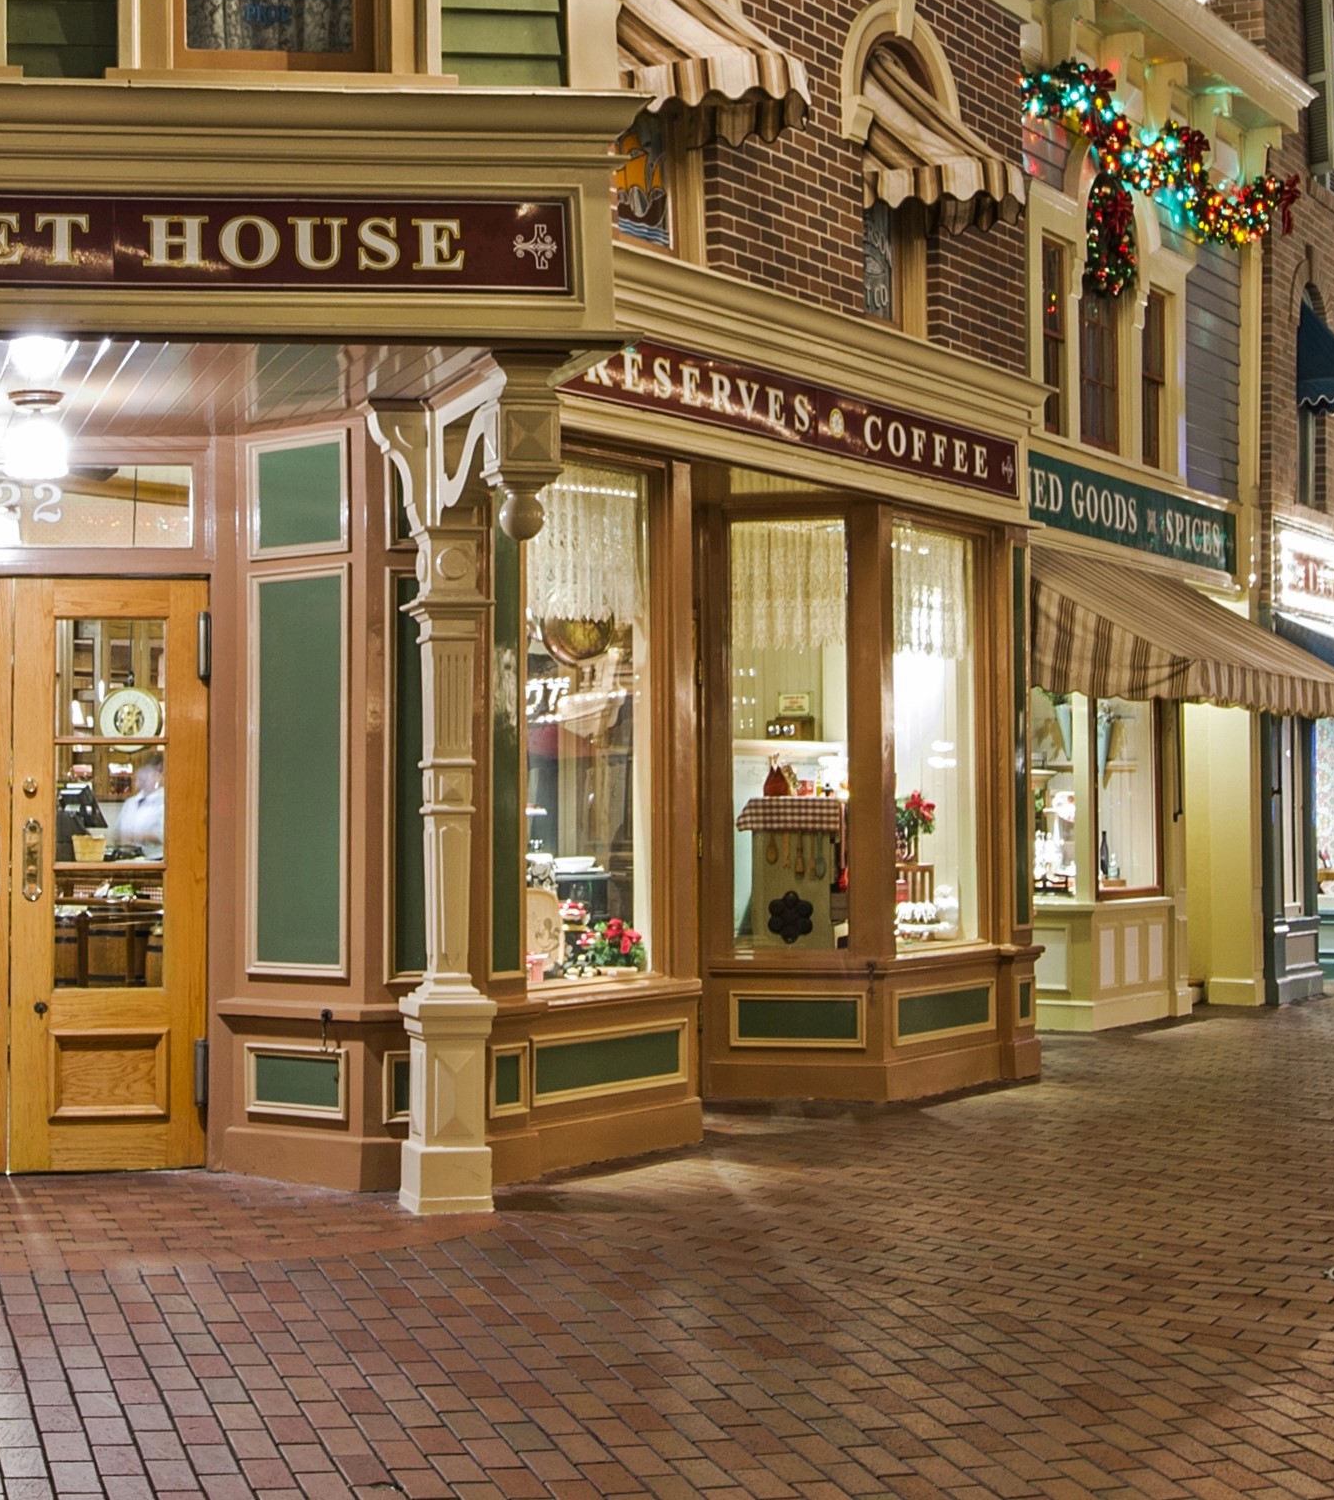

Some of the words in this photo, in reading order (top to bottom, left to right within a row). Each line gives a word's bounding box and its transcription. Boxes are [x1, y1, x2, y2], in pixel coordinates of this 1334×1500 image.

[143, 212, 466, 272] HOUSE
[864, 415, 989, 480] COFFEE
[1071, 480, 1138, 534] GOODS
[1165, 509, 1221, 557] SPICES
